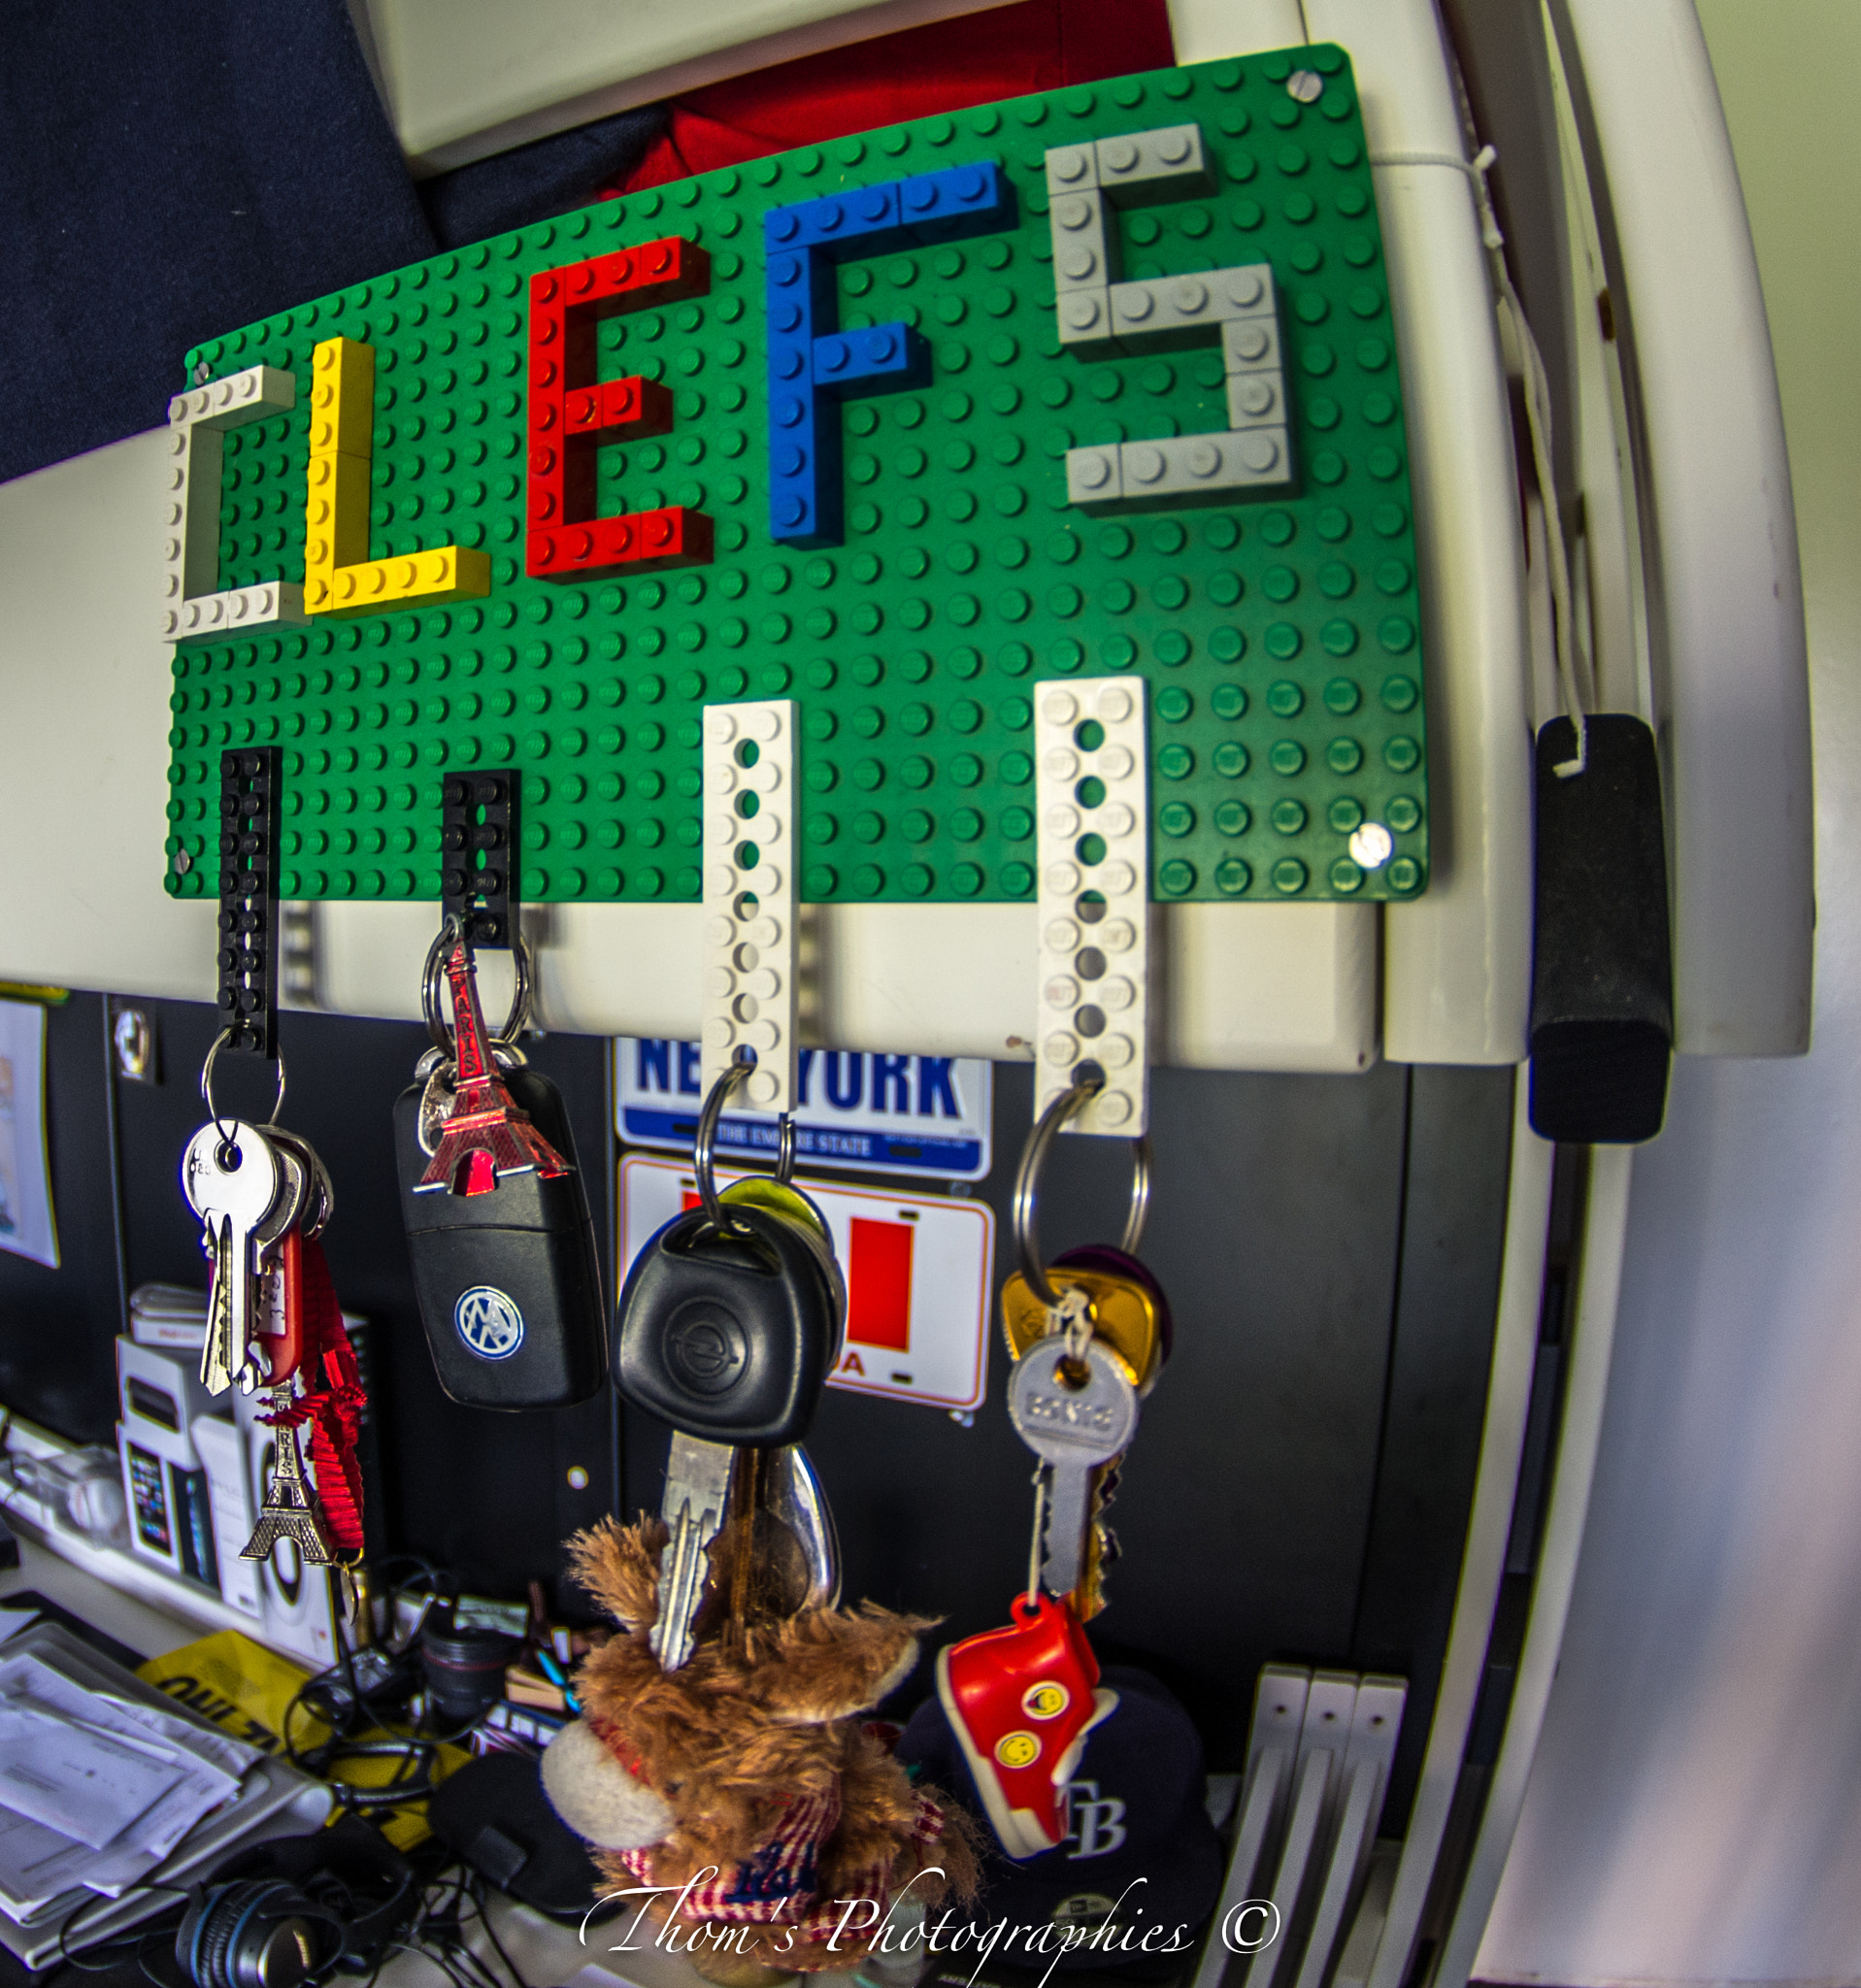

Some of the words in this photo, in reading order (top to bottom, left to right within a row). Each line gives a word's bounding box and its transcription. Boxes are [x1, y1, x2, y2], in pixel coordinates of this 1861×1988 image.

[163, 122, 1301, 644] CLEFS
[451, 977, 479, 1074] PARIS
[637, 1038, 703, 1096] NE
[717, 1124, 748, 1143] THE
[751, 1129, 814, 1152] EMRE
[817, 1136, 872, 1156] STATE
